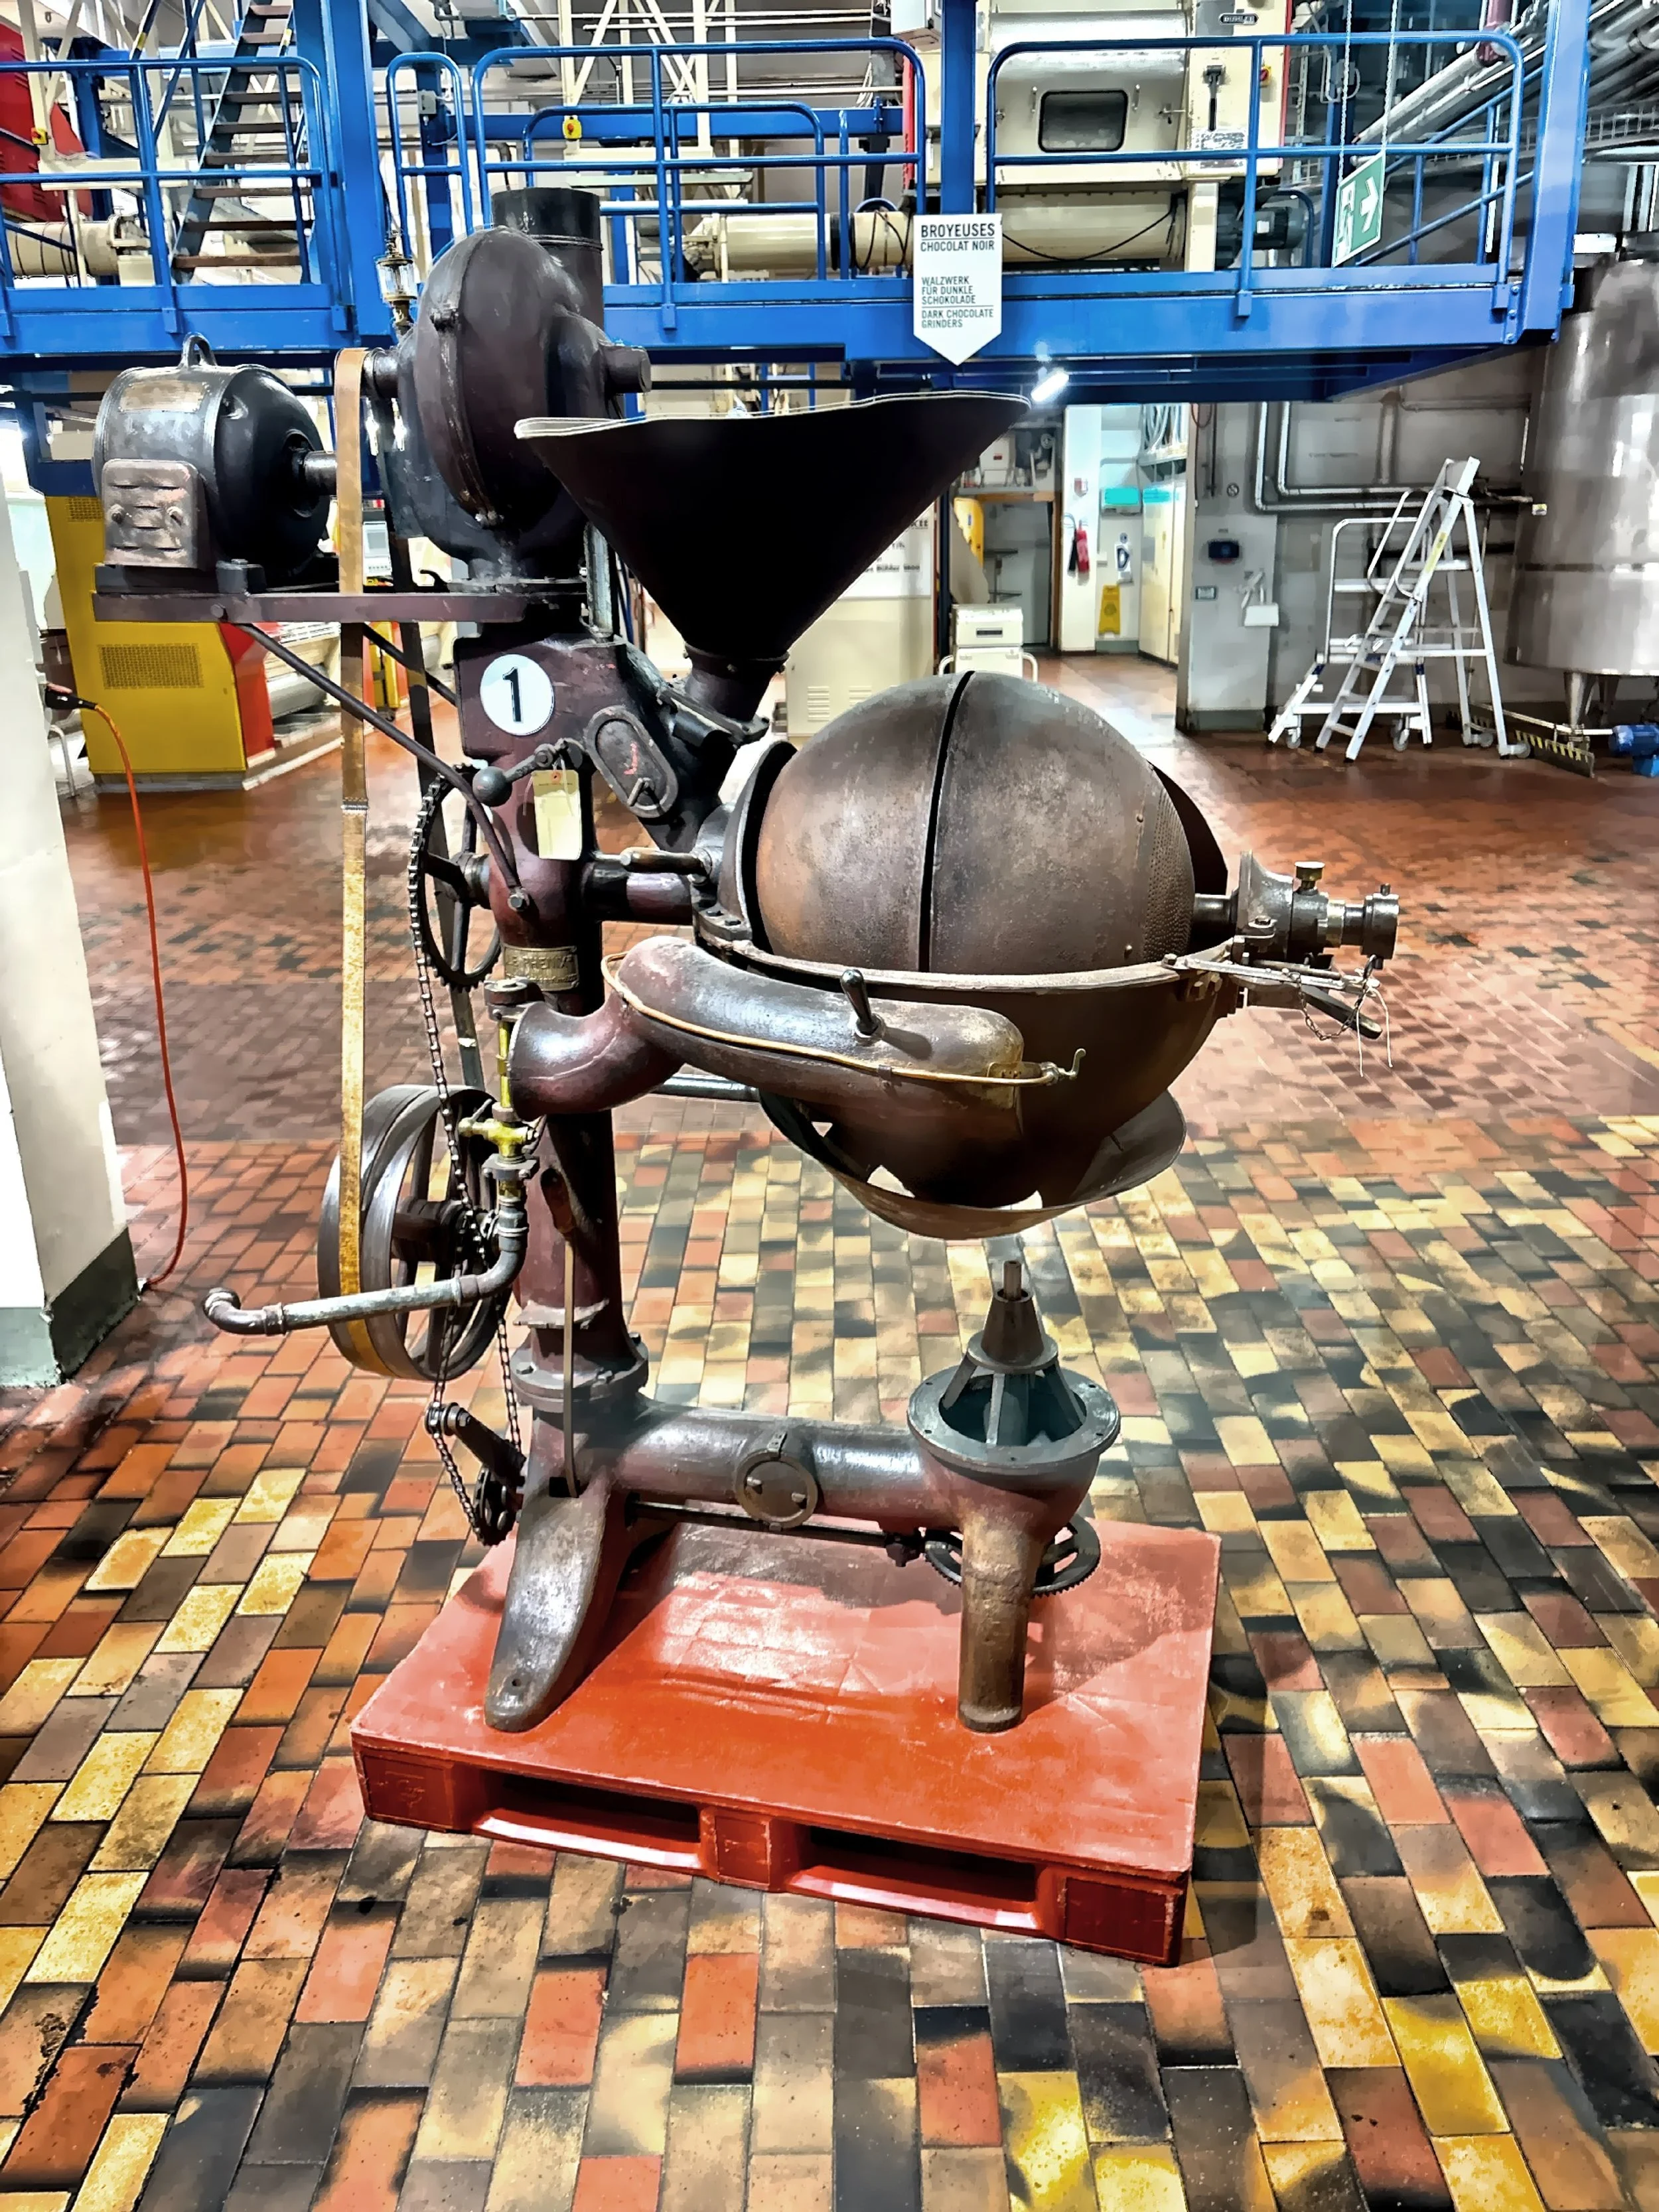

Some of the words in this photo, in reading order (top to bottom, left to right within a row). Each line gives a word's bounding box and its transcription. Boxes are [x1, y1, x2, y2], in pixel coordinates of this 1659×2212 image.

[920, 223, 995, 238] BROYEUSES
[920, 241, 969, 252] CHOCOLAT
[972, 240, 995, 251] NOIR
[921, 276, 970, 285] WALZWERK
[921, 285, 938, 295] FÜR
[940, 286, 974, 295] DUNKLE
[921, 295, 976, 305] SCHOKOLADE
[921, 310, 944, 319] DARK
[946, 309, 994, 318] CHOCOLATE
[921, 319, 963, 328] GRINDERS
[502, 667, 522, 723] 1
